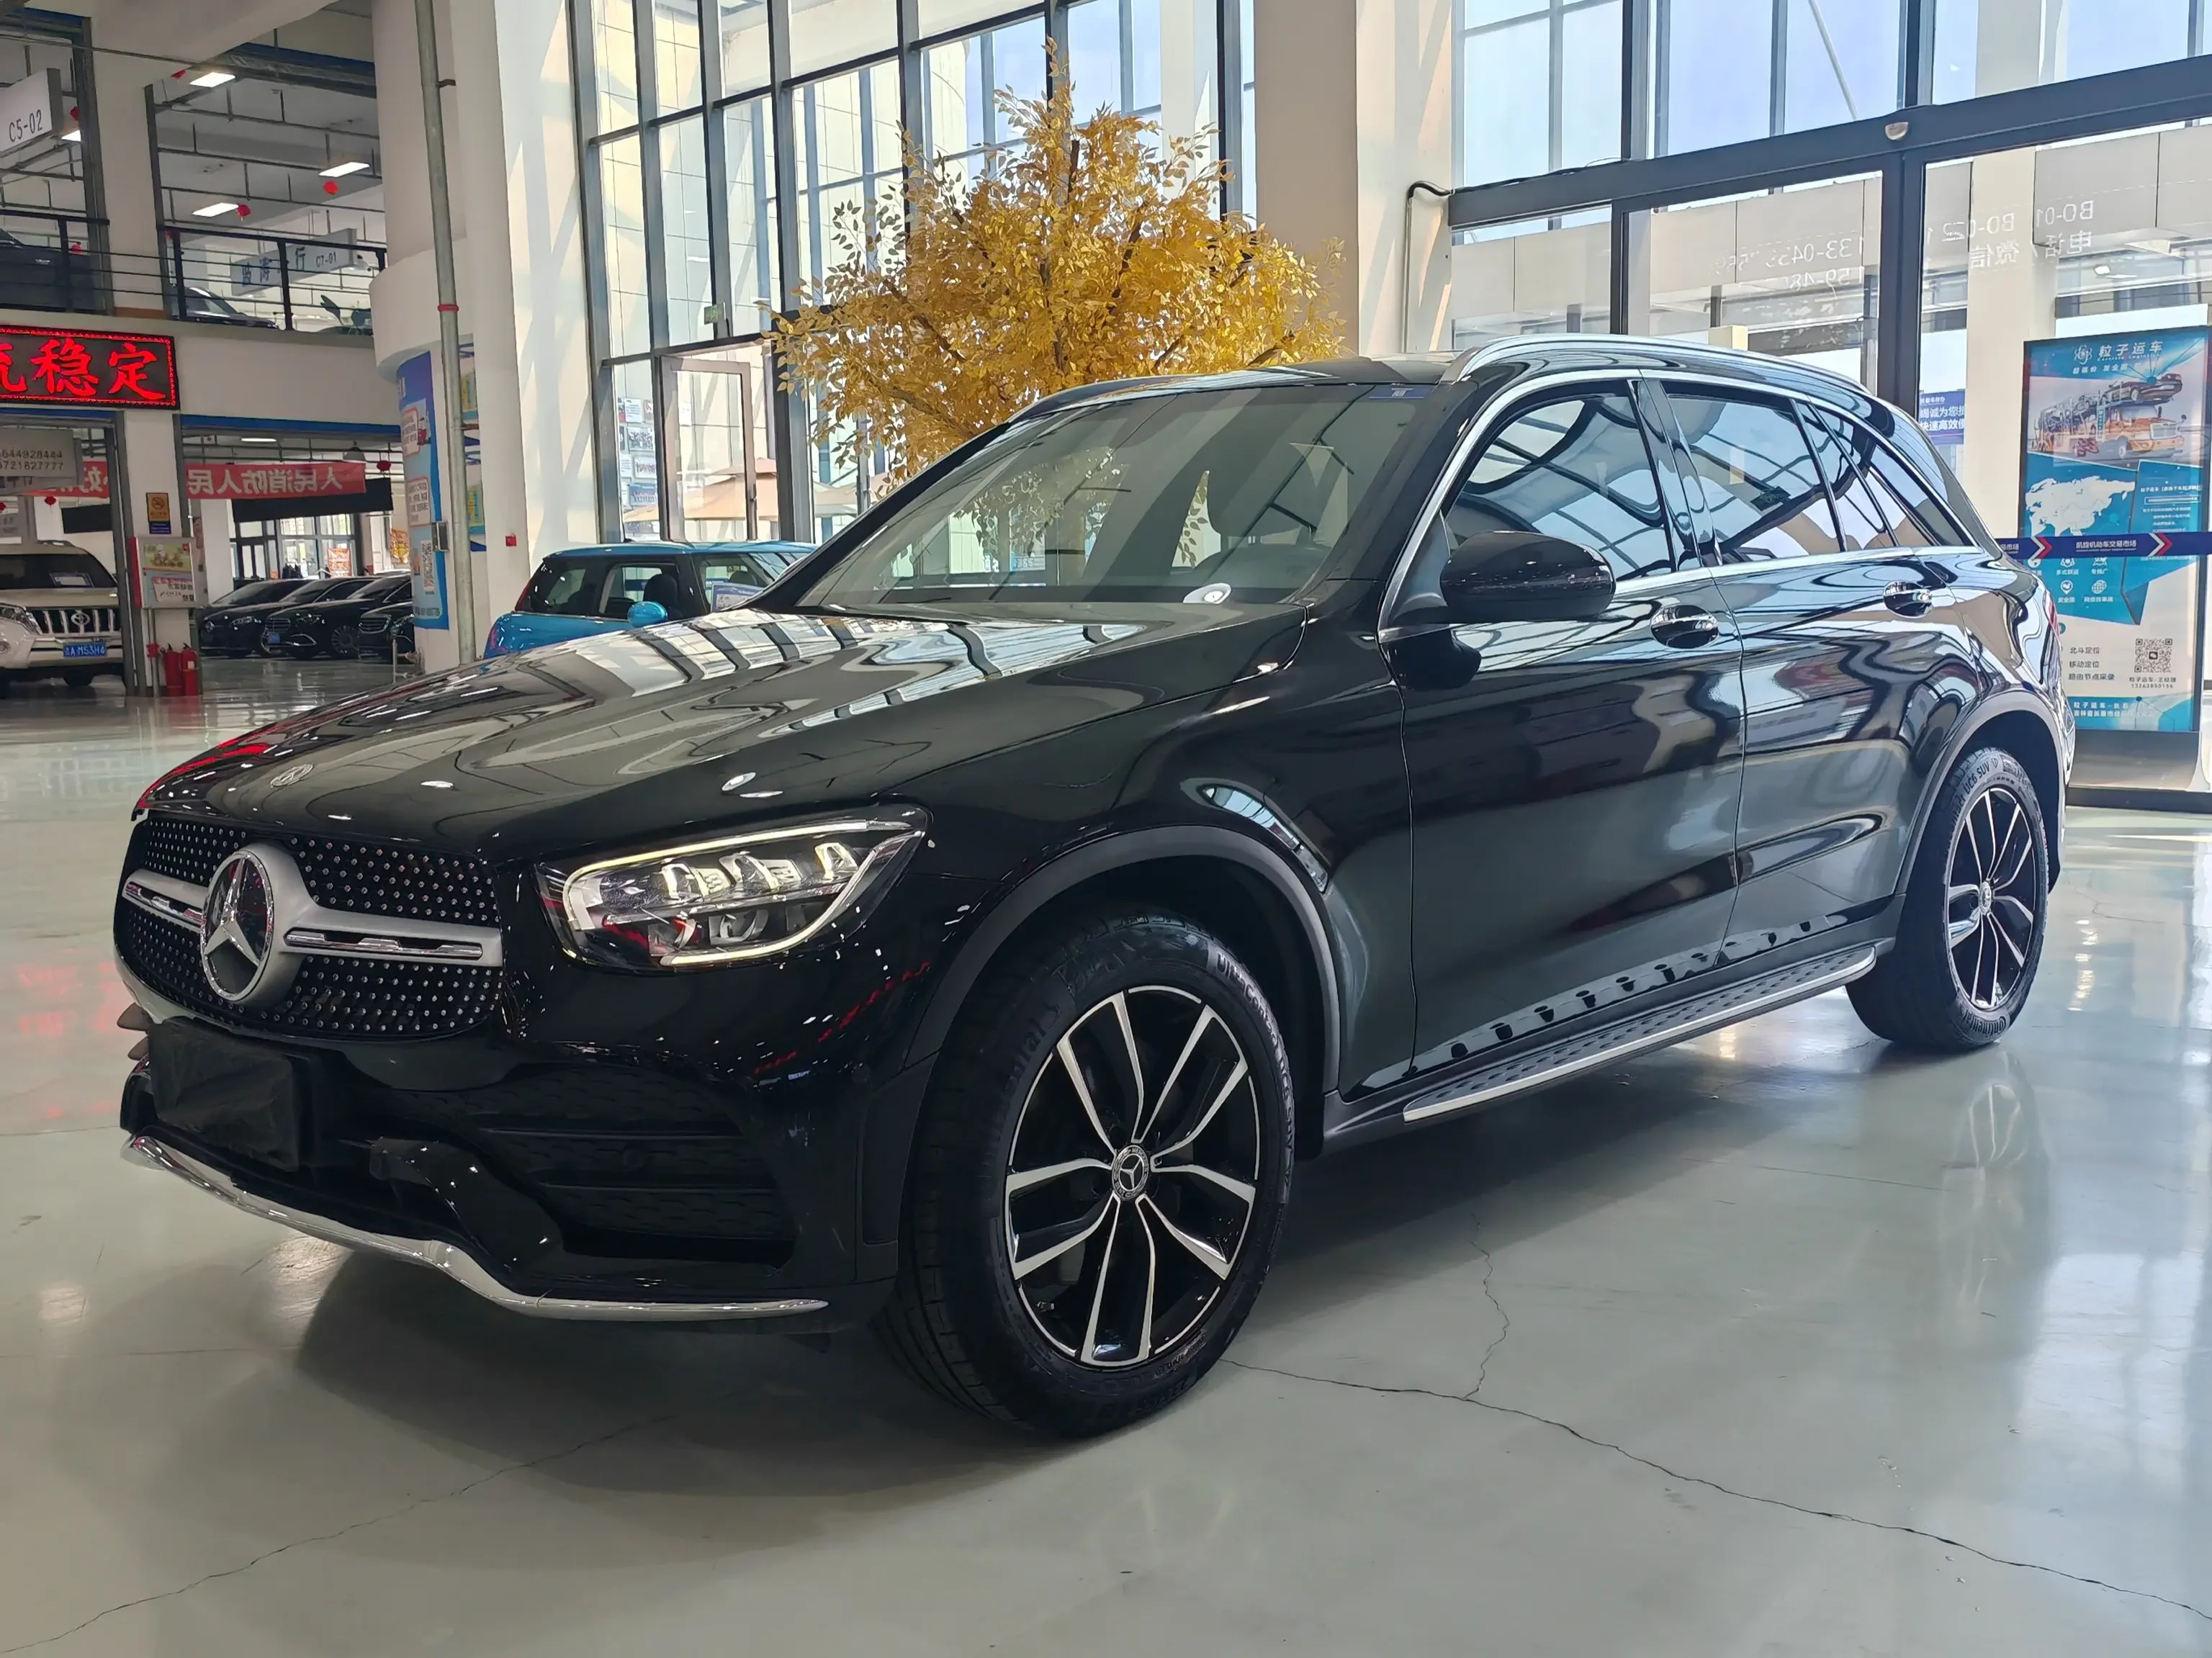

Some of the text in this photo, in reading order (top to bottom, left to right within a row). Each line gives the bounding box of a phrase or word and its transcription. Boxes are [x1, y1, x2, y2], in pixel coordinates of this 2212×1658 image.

[9, 109, 43, 143] C5-02
[315, 251, 337, 267] C7-01
[2098, 341, 2163, 358] 粒子运车
[0, 449, 63, 459] 644928444
[1963, 761, 1990, 795] UC6 SUV
